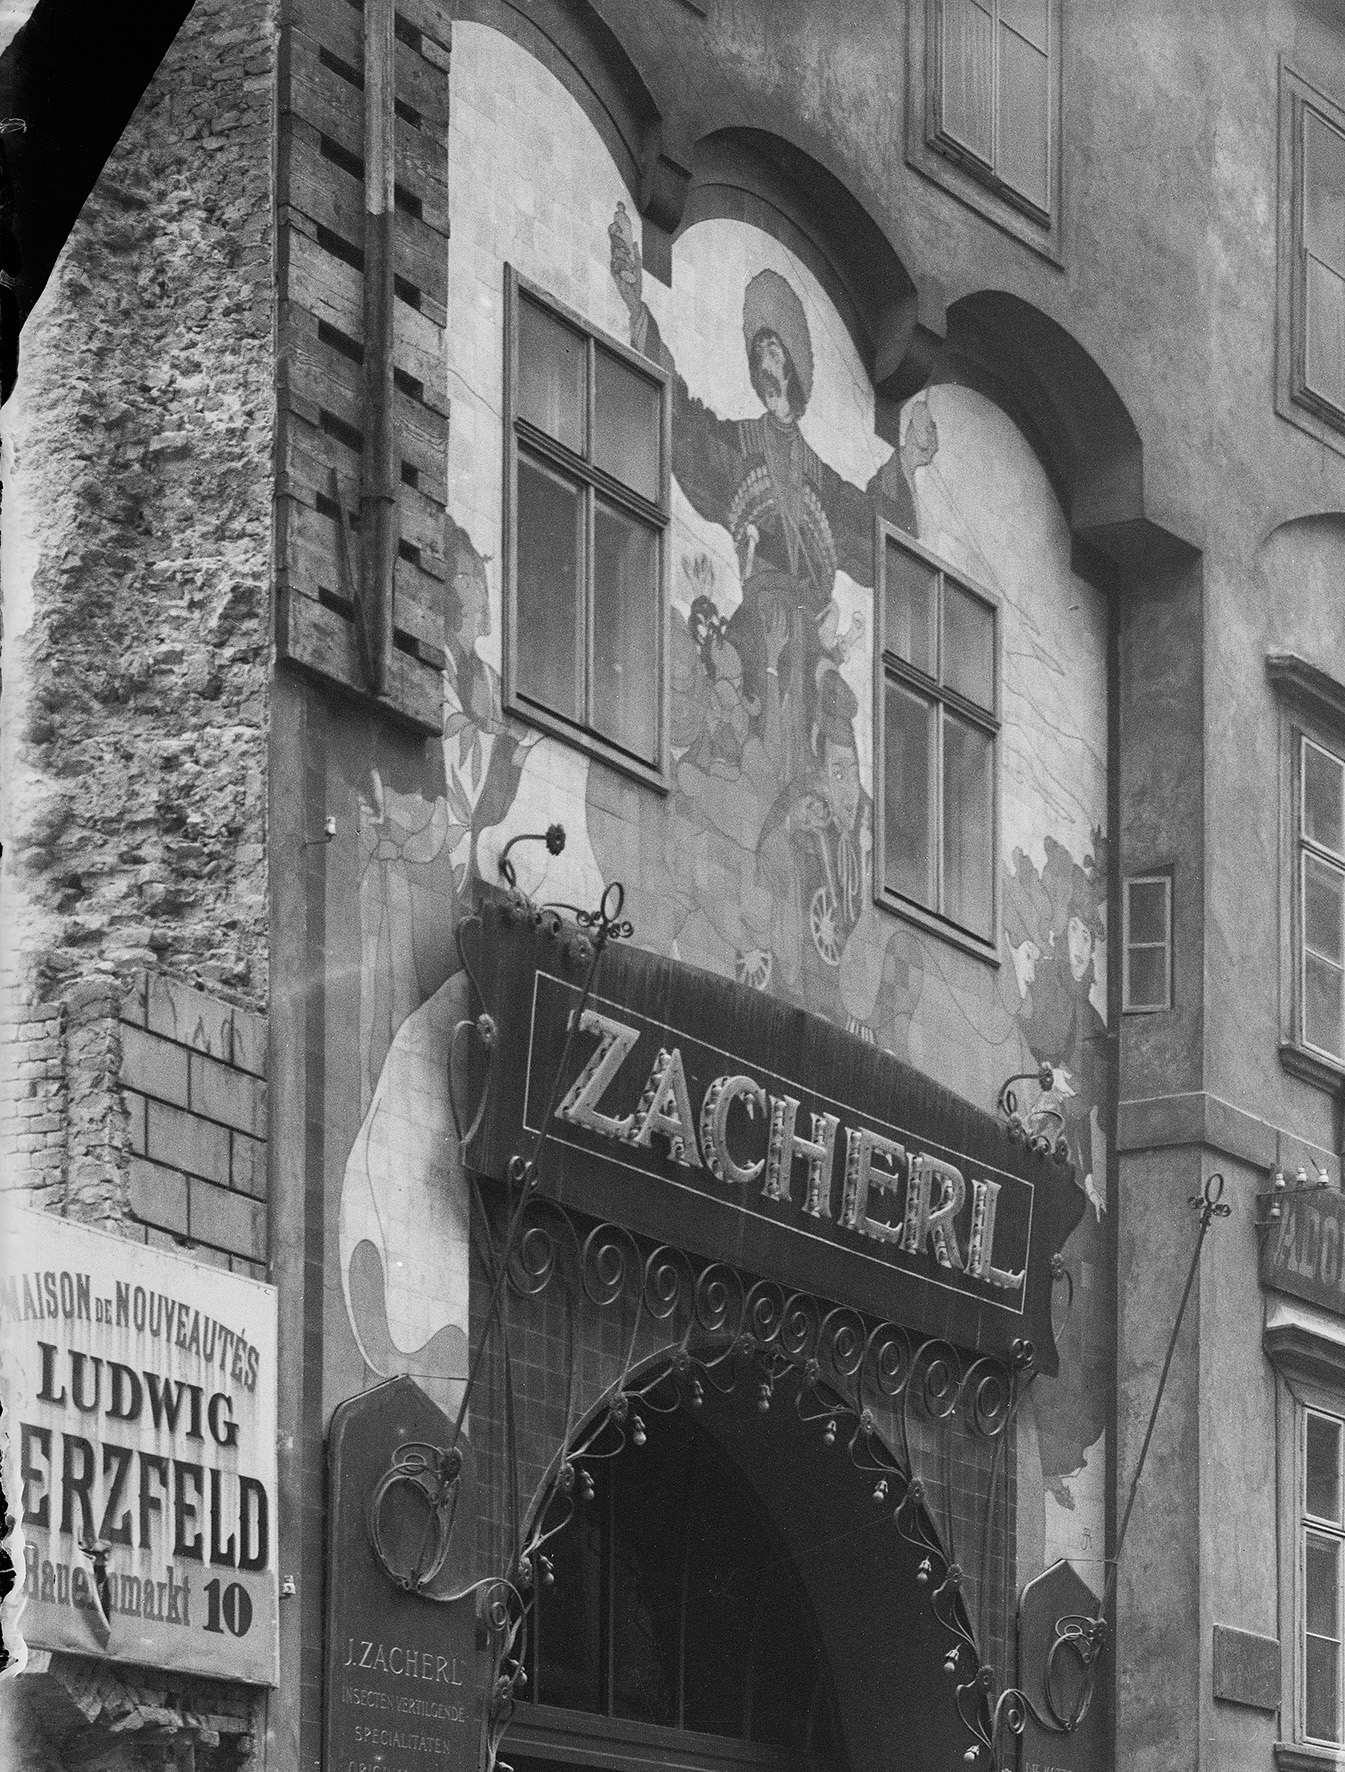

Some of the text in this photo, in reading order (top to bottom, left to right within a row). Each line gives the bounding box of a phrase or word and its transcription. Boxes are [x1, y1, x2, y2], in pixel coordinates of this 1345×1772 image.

[556, 1009, 1025, 1290] ZACHERL
[4, 1270, 260, 1393] MAISON DE NOUVEAUTÉS
[36, 1341, 240, 1448] LUDWIG
[23, 1541, 253, 1638] Bauenmarkt 10
